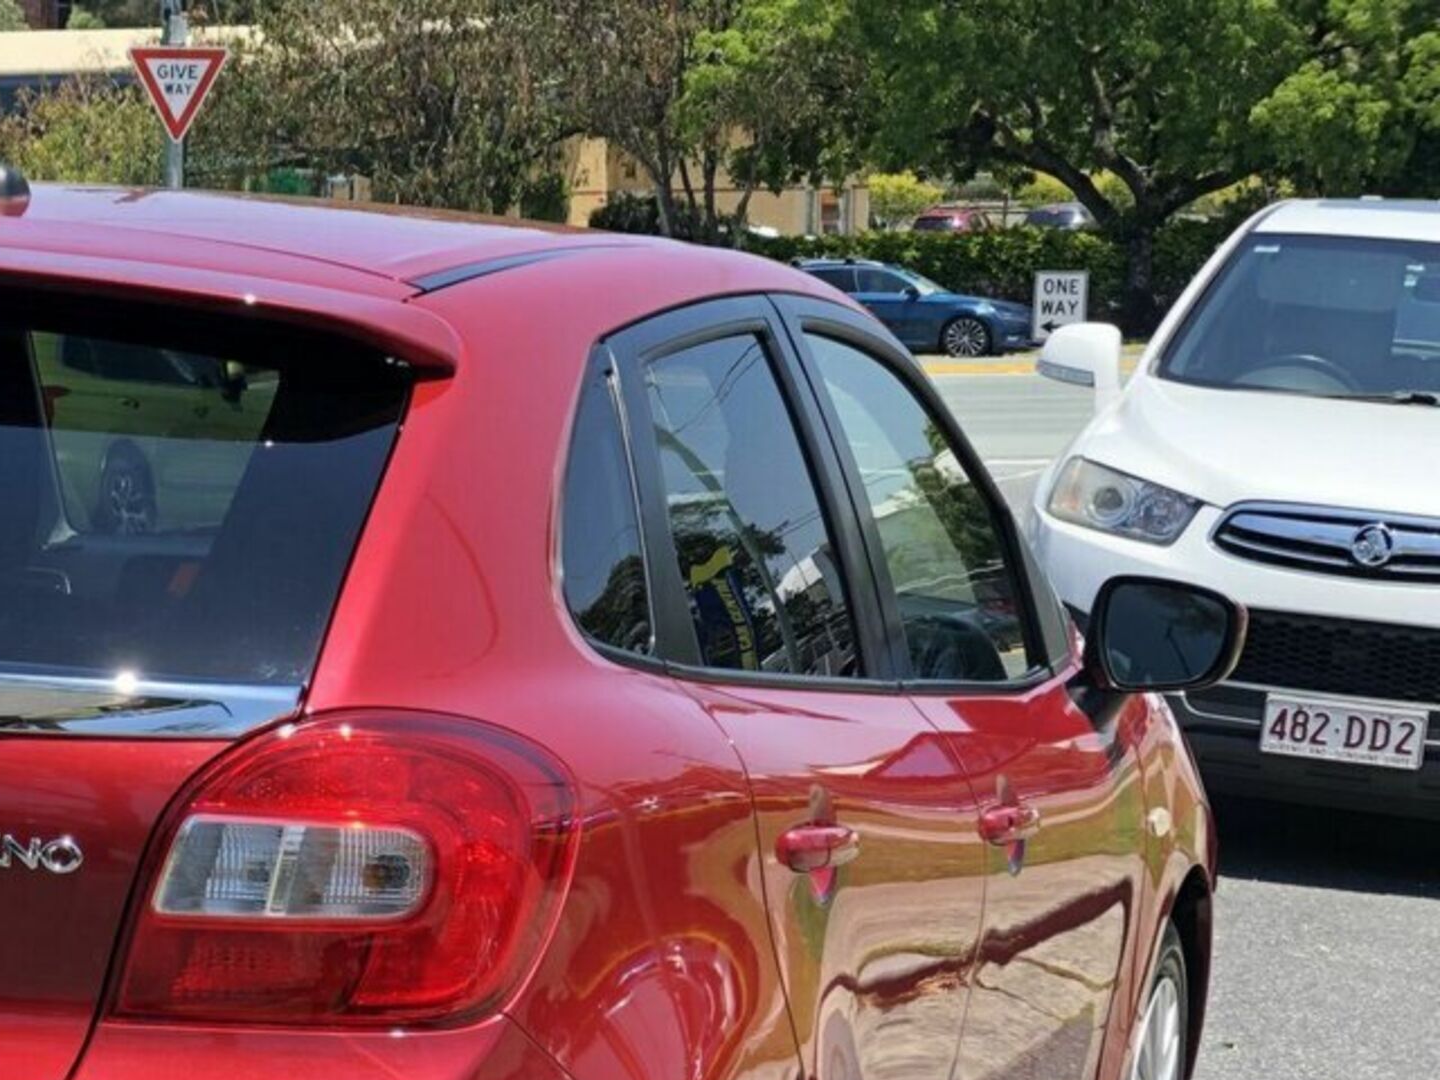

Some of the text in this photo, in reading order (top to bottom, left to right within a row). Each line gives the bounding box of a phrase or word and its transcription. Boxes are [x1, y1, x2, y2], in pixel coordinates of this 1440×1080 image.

[157, 64, 198, 79] GIVE
[165, 83, 192, 94] WAY
[1044, 278, 1079, 295] ONE
[1041, 300, 1079, 316] WAY
